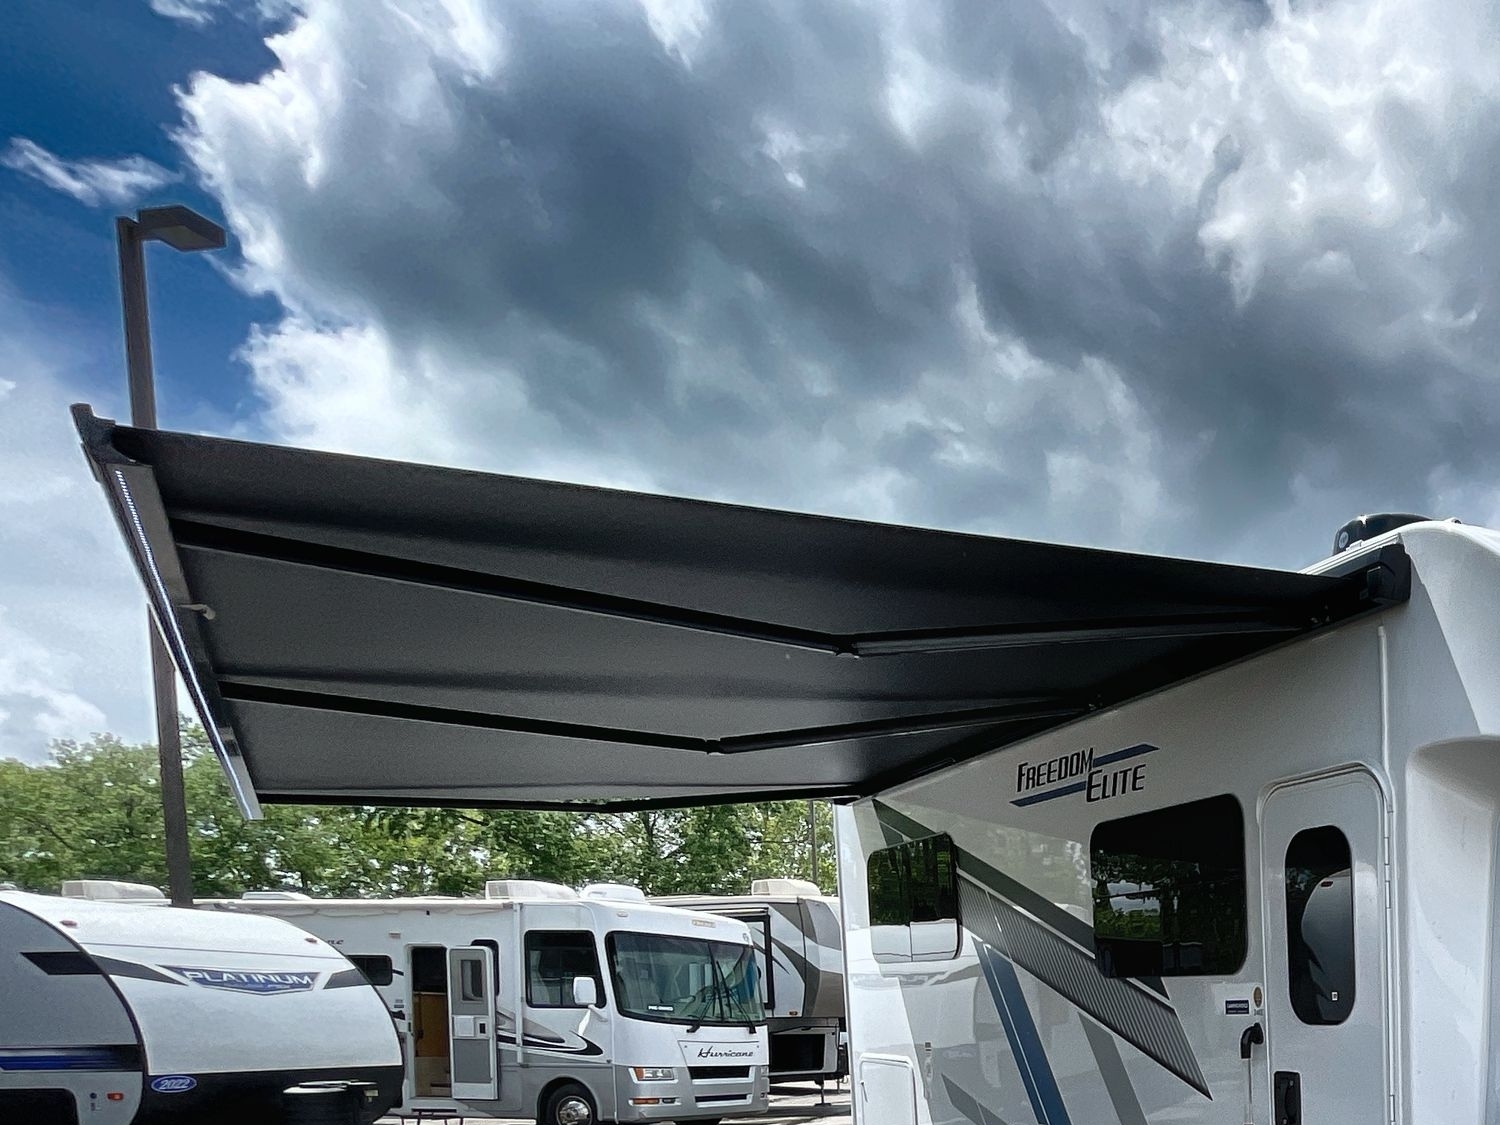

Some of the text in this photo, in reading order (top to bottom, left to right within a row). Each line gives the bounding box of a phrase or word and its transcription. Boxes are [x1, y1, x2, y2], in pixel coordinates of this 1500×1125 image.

[1017, 748, 1094, 792] FREEDOM
[1086, 764, 1146, 803] ELITE
[183, 970, 314, 985] PLATINUM
[697, 1045, 754, 1058] Hurricane
[159, 1079, 191, 1090] 2022
